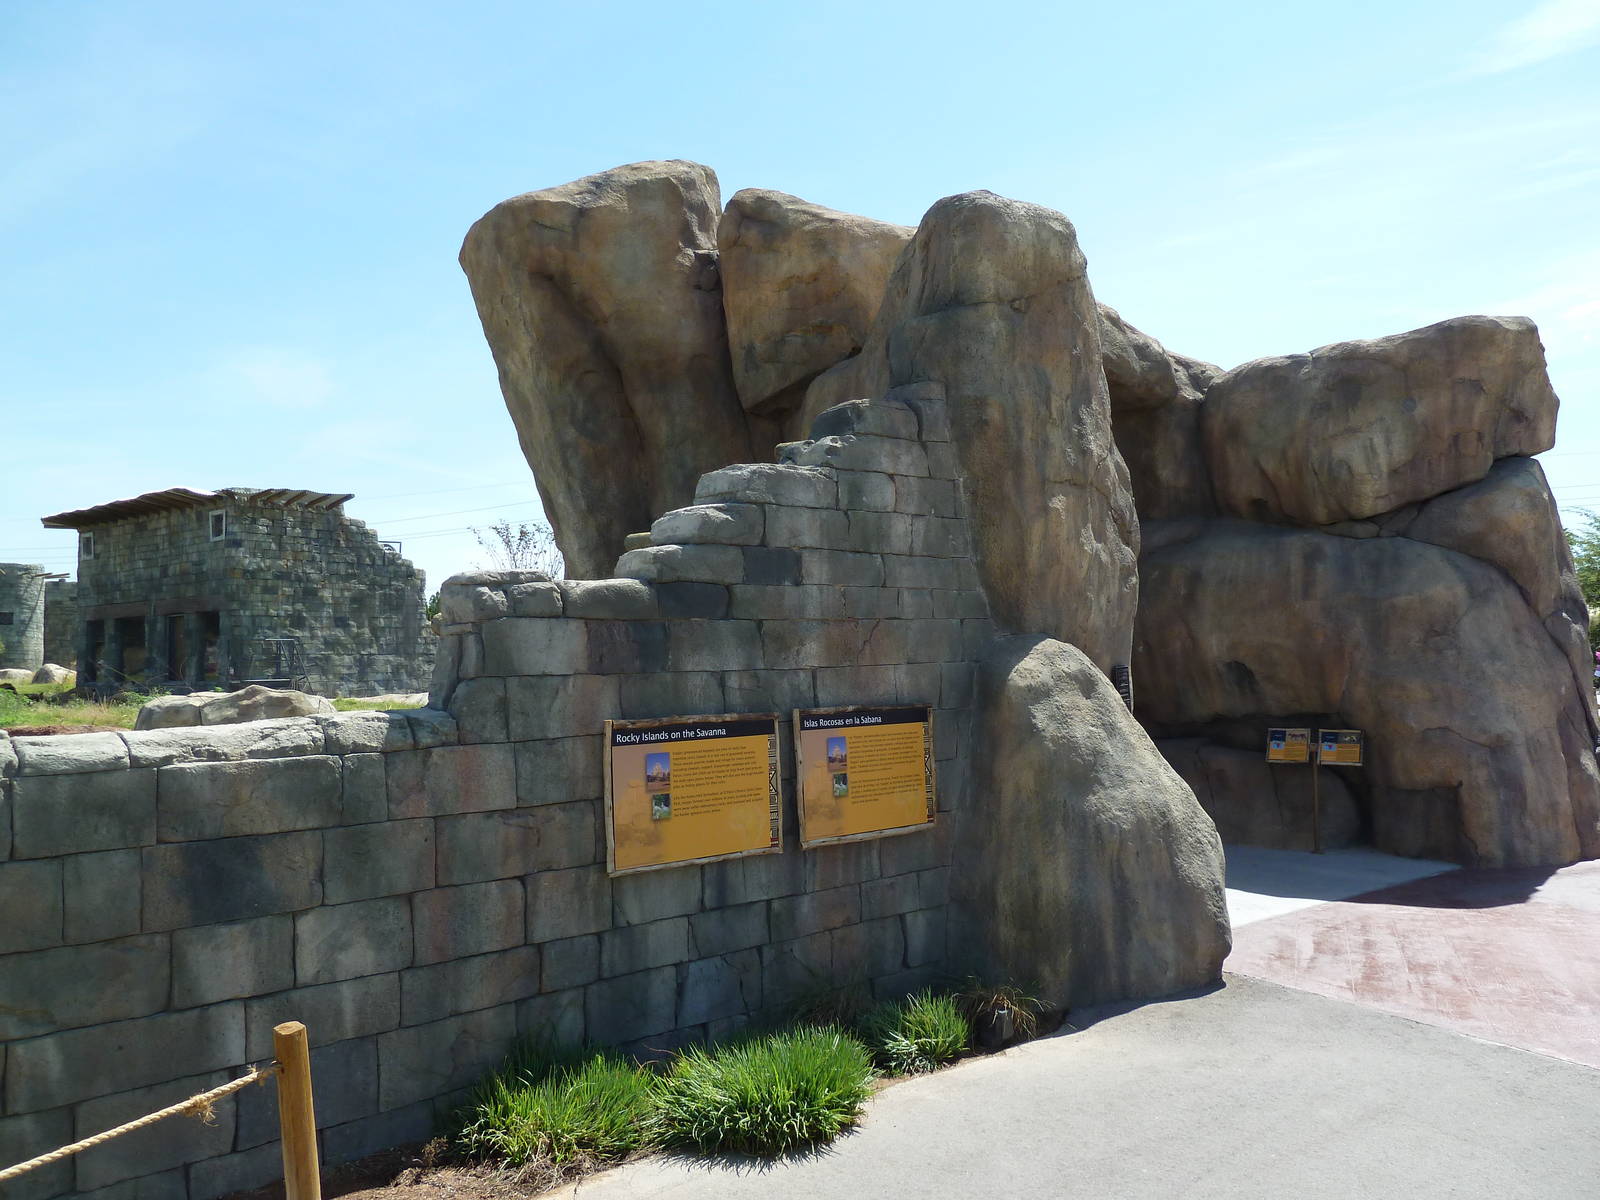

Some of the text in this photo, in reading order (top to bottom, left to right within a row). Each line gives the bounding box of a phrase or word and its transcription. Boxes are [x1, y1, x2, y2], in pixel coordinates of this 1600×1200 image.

[804, 719, 818, 728] Islas
[854, 716, 860, 724] la
[861, 716, 882, 724] Sabana
[616, 734, 640, 743] Rocky
[642, 731, 668, 741] Islands
[683, 729, 695, 738] the
[697, 728, 726, 737] Savanna
